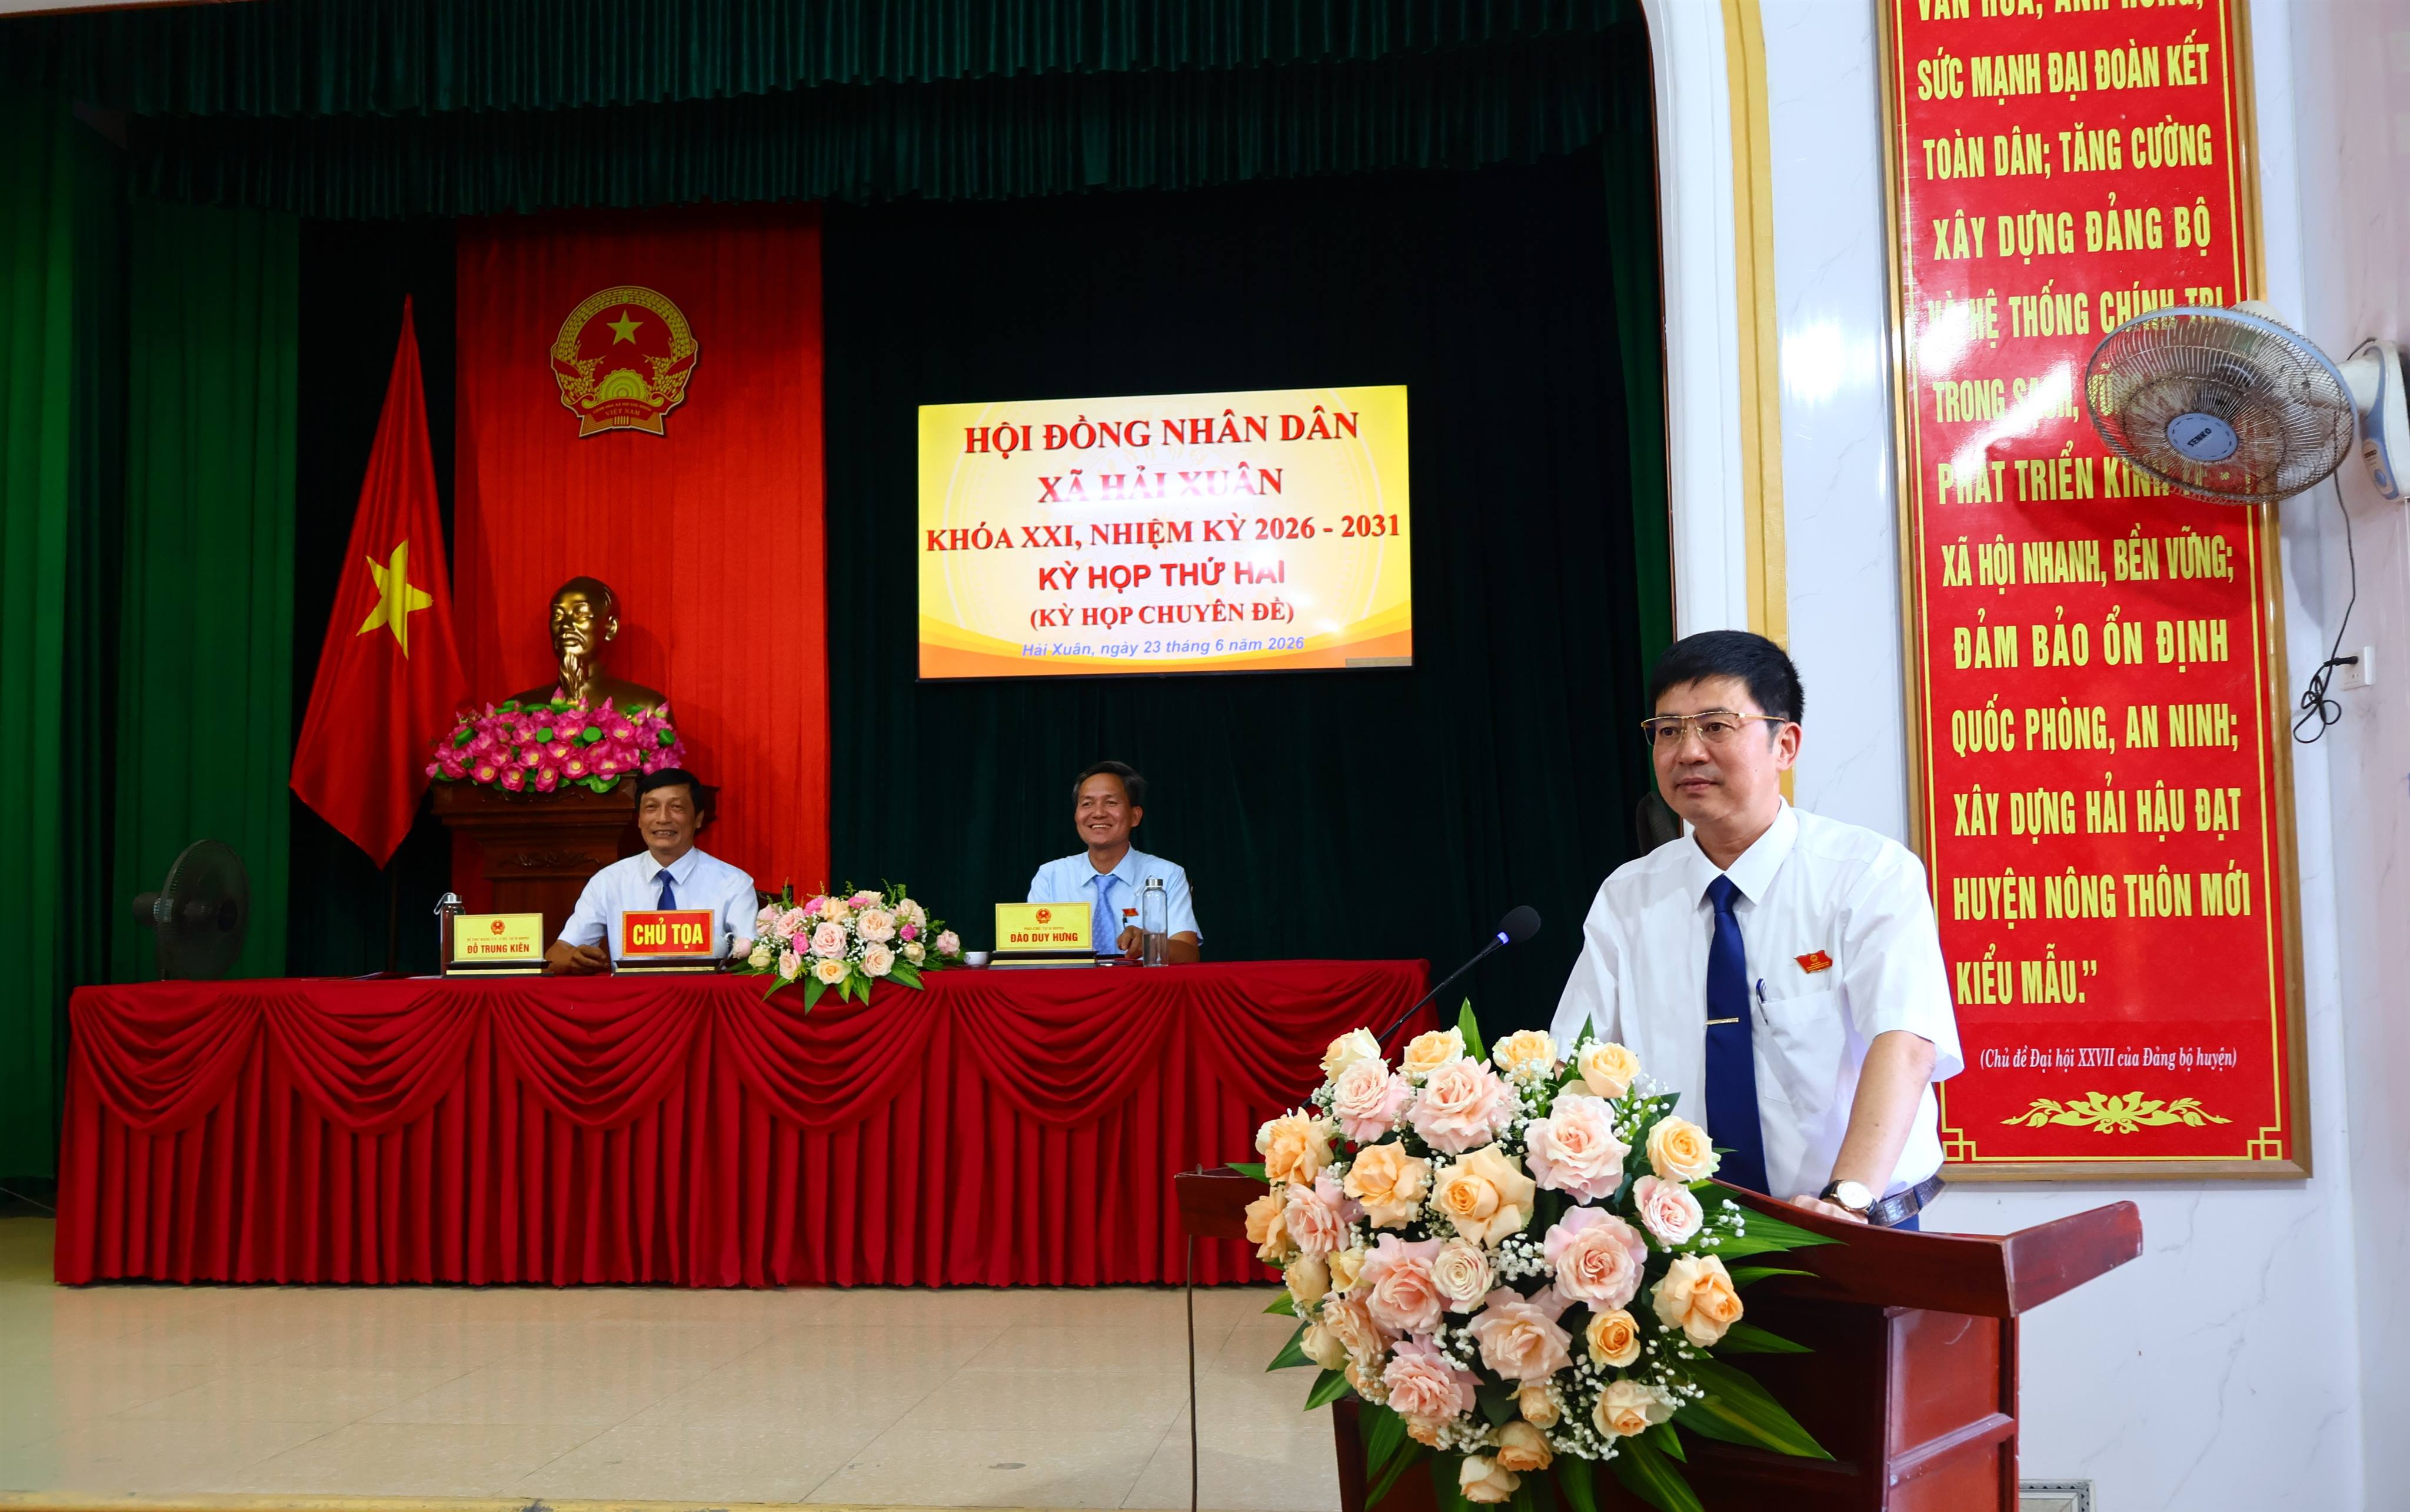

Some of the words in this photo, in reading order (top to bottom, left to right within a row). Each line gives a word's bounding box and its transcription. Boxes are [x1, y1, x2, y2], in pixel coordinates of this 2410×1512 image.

[1918, 47, 1963, 101] SỨC
[1971, 54, 2041, 105] MẠNH
[2048, 51, 2088, 101] ĐẠI
[2095, 39, 2159, 90] ĐOÀN
[2167, 29, 2209, 86] KẾT
[1923, 129, 1985, 179] TOÀN
[1994, 125, 2051, 179] DÂN;
[2059, 122, 2122, 172] TĂNG
[2132, 115, 2212, 169] CƯỜNG
[1933, 209, 1985, 260] XÂY
[1998, 210, 2074, 264] DỰNG
[2086, 192, 2162, 252] ĐẢNG
[2174, 197, 2210, 256] BỘ
[1969, 288, 1999, 348] HỆ
[2008, 279, 2089, 337] THỐNG
[1932, 379, 2005, 422] TRONG
[2013, 378, 2079, 428] SH,
[964, 422, 1033, 459] HỘI
[1043, 415, 1151, 450] ĐỒNG
[1161, 409, 1269, 445] NHÂN
[1279, 405, 1359, 441] DÂN
[2187, 428, 2212, 447] SENKO
[1038, 469, 1089, 503] XÃ
[1099, 465, 1167, 500] HẢI
[1177, 461, 1283, 496] XUÂN
[2015, 440, 2093, 501] TRIỂN
[926, 521, 1014, 551] KHÓA
[1020, 525, 1083, 551] XXI,
[1090, 518, 1193, 549] NHIỆM
[1203, 512, 1247, 542] KỲ
[1255, 517, 1315, 540] 2026
[1341, 514, 1400, 537] 2031
[1942, 537, 1972, 587] XÃ
[1978, 534, 2015, 594] HỘI
[2022, 540, 2106, 587] NHANH,
[2114, 523, 2159, 581] BỀN
[2166, 527, 2233, 582] VỮNG;
[1039, 561, 1078, 591] KỲ
[1089, 564, 1151, 594] HỌP
[1160, 557, 1226, 586] THỨ
[1234, 560, 1285, 584] HAI
[1030, 602, 1074, 631] (KỲ
[1081, 607, 1133, 630] HỌP
[1139, 598, 1244, 624] CHUYÊN
[1251, 597, 1294, 624] ĐỀ)
[1954, 608, 2018, 669] ĐẢM
[2032, 605, 2089, 667] BẢO
[2103, 605, 2142, 665] ỔN
[2156, 620, 2228, 672] ĐỊNH
[1052, 642, 1095, 657] Xuân,
[1101, 641, 1139, 657] ngày
[1143, 641, 1161, 653] 23
[1166, 640, 1210, 655] tháng
[1216, 639, 1224, 651] 6
[1229, 638, 1262, 651] năm
[1268, 636, 1304, 650] 2026
[1952, 694, 2015, 757] QUỐC
[2026, 697, 2115, 754] PHÒNG,
[2126, 705, 2158, 748] AN
[2169, 704, 2238, 751] NINH;
[1954, 784, 1999, 836] XÂY
[2010, 788, 2075, 844] DỰNG
[2086, 772, 2126, 833] HẢI
[2137, 780, 2185, 841] HẬU
[2195, 788, 2241, 841] ĐẠT
[1953, 867, 2036, 929] HUYỆN
[2045, 866, 2116, 918] NÔNG
[2123, 865, 2192, 917] THÔN
[2201, 860, 2250, 916] MỚI
[481, 944, 507, 953] TRUNG
[510, 942, 530, 953] KIÊN
[633, 917, 667, 945] CHỦ
[671, 923, 704, 949] TỌA
[1011, 932, 1028, 942] ĐÀO
[1032, 934, 1050, 942] DUY
[1957, 944, 2012, 1004] KIỂU
[1980, 1047, 2009, 1070] (Chủ
[2013, 1045, 2029, 1068] đề
[2030, 1048, 2052, 1073] Đại
[2056, 1048, 2075, 1073] hội
[2078, 1048, 2115, 1067] XXVII
[2118, 1046, 2139, 1067] của
[2142, 1046, 2176, 1071] Đảng
[2179, 1047, 2193, 1072] bộ
[2196, 1047, 2237, 1072] huyện)
